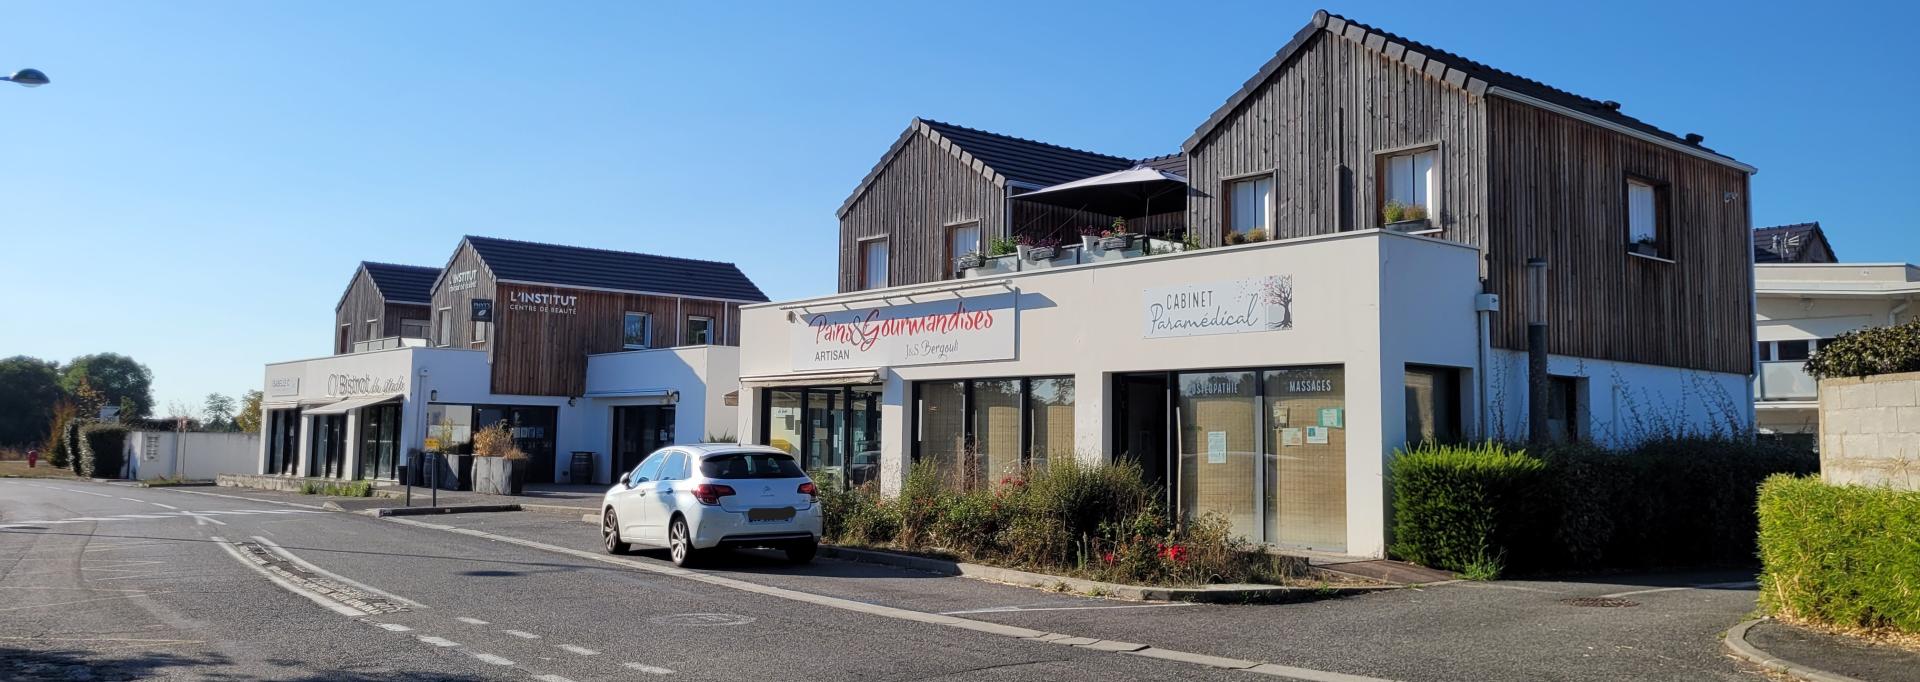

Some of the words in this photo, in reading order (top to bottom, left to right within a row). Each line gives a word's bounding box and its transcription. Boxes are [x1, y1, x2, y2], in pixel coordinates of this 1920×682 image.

[510, 291, 577, 306] L'INSTITUT
[1166, 290, 1213, 310] CABINET
[509, 304, 537, 312] CENTRE
[1151, 292, 1259, 334] Paramédical
[860, 301, 994, 352] Gourmandises
[814, 349, 850, 362] ARTISAN
[1289, 379, 1332, 392] MASSAGES
